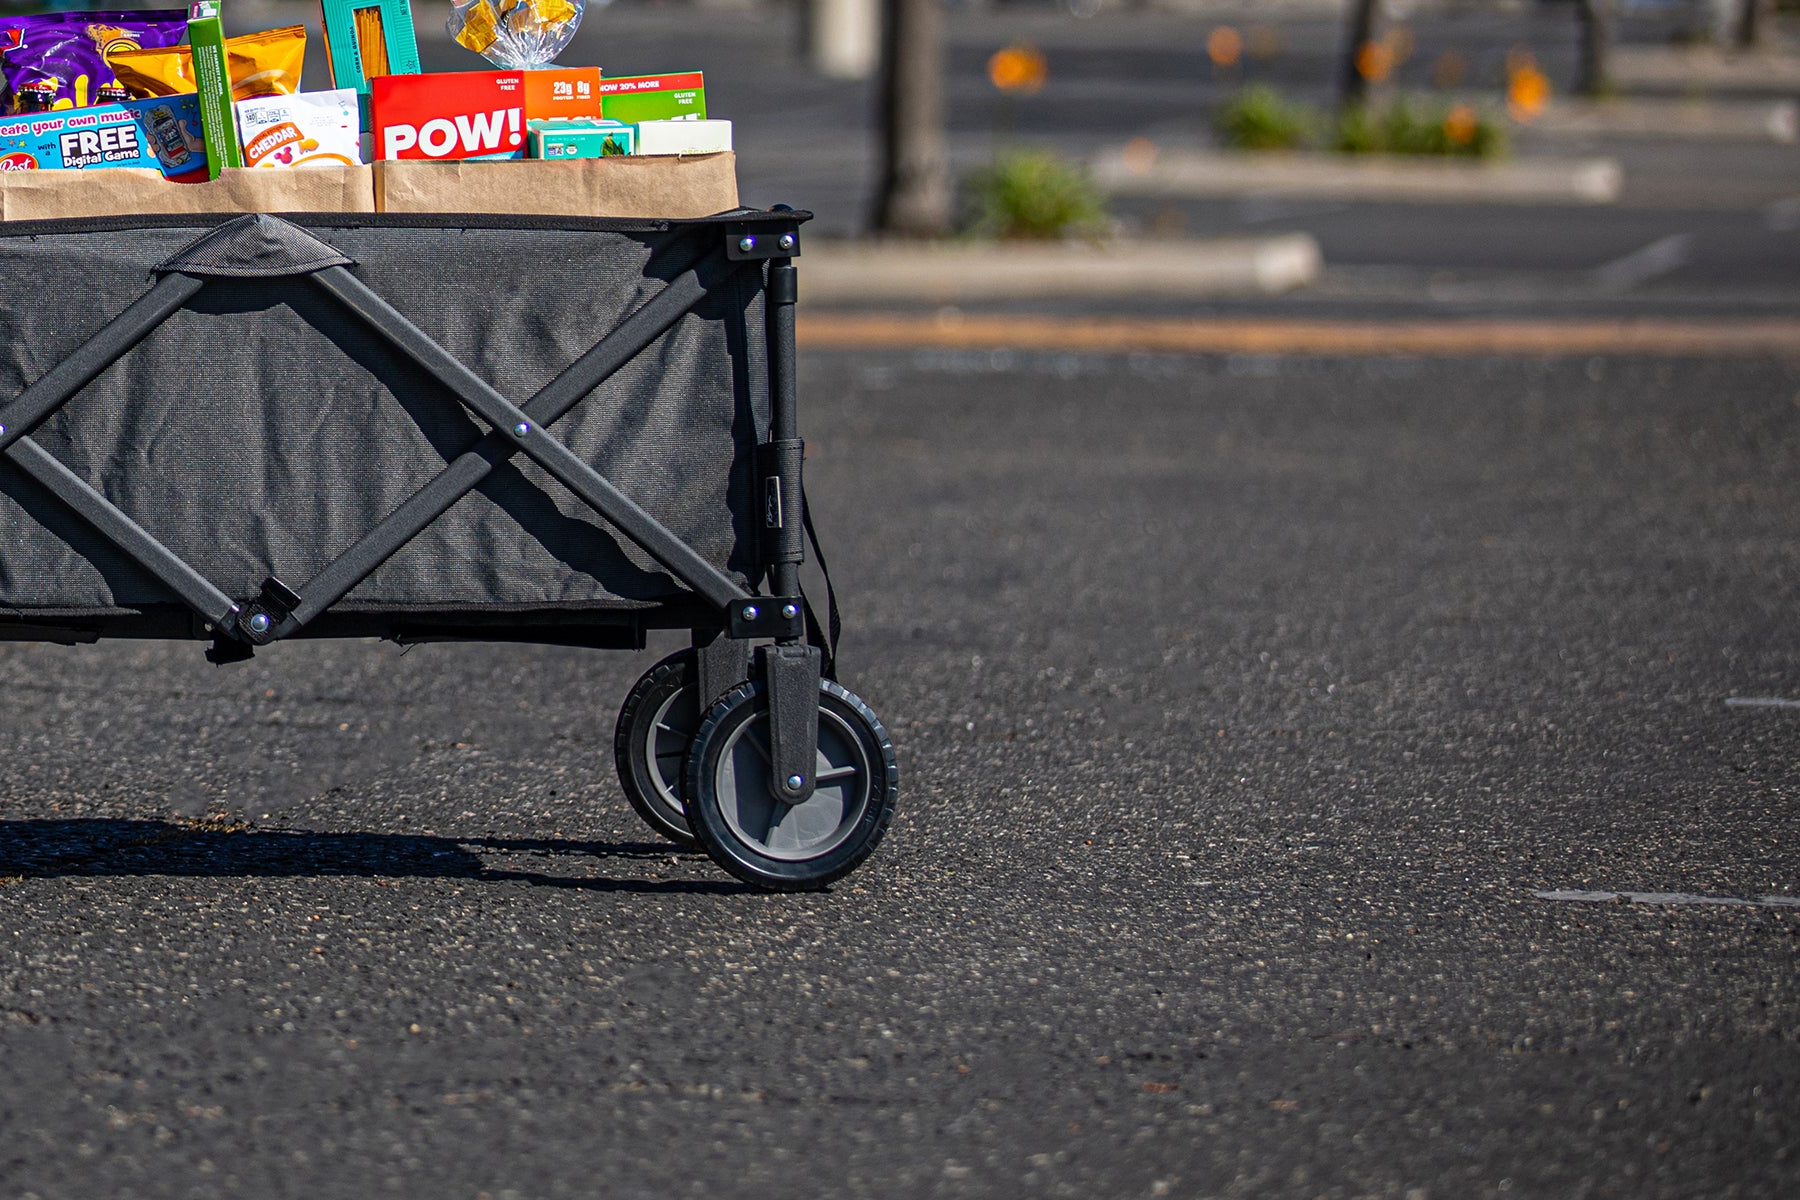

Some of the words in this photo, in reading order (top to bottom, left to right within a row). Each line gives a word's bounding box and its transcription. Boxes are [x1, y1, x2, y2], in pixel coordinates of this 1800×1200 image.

[349, 26, 357, 50] QUINOA
[553, 81, 572, 95] 23g
[577, 80, 590, 95] 8g
[619, 82, 636, 90] 20%
[638, 80, 659, 89] MORE
[33, 120, 63, 135] your
[69, 116, 96, 127] own
[101, 109, 141, 123] music
[384, 108, 522, 160] POW!
[38, 142, 57, 151] with
[60, 125, 139, 157] FREE
[249, 126, 298, 159] CHEDDAR
[63, 152, 102, 168] Digital
[105, 148, 140, 162] Game
